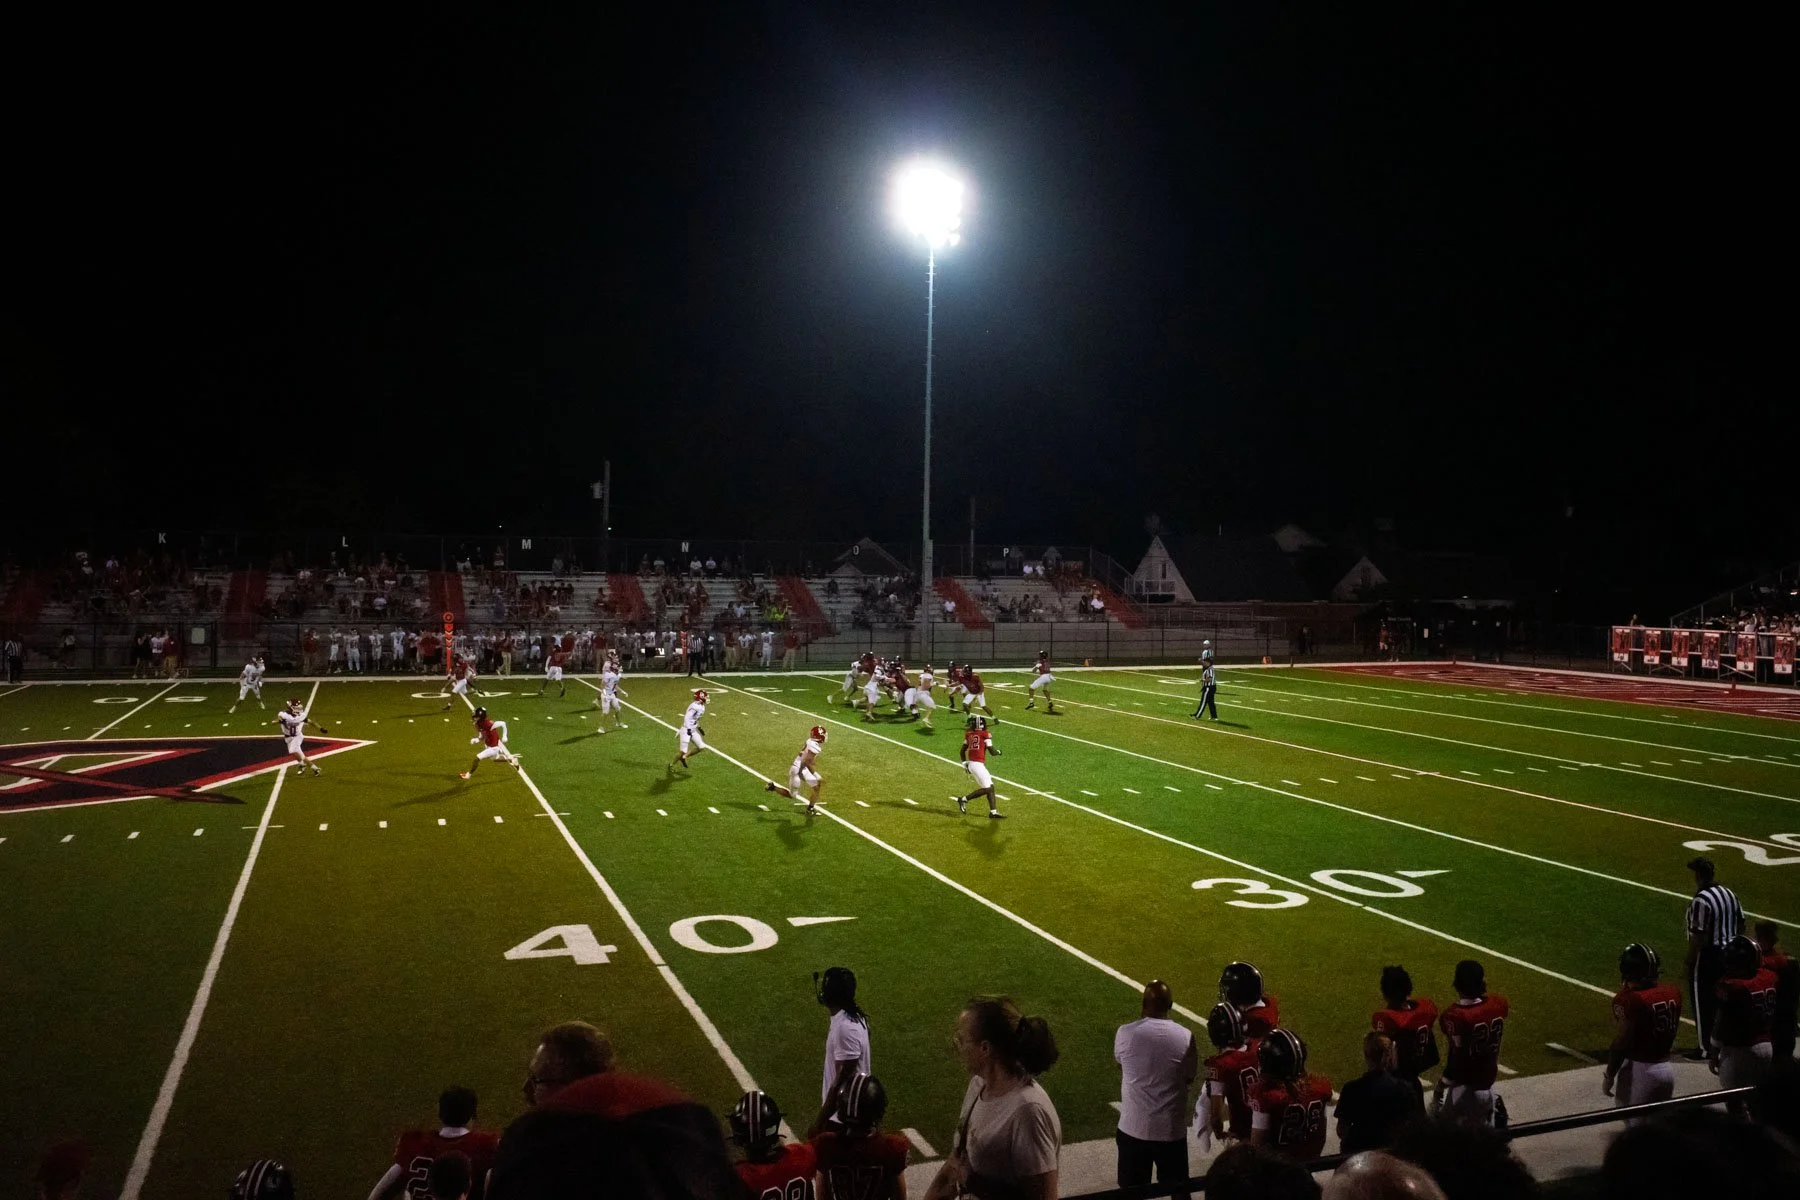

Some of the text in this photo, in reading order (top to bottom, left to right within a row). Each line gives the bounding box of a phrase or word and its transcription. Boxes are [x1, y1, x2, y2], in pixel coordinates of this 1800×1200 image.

[158, 531, 167, 544] K
[342, 535, 349, 547] L
[521, 538, 532, 550] M
[681, 541, 690, 553] N
[853, 545, 860, 556] O
[1003, 547, 1010, 558] P
[1190, 869, 1425, 910] 30
[503, 914, 779, 965] 40
